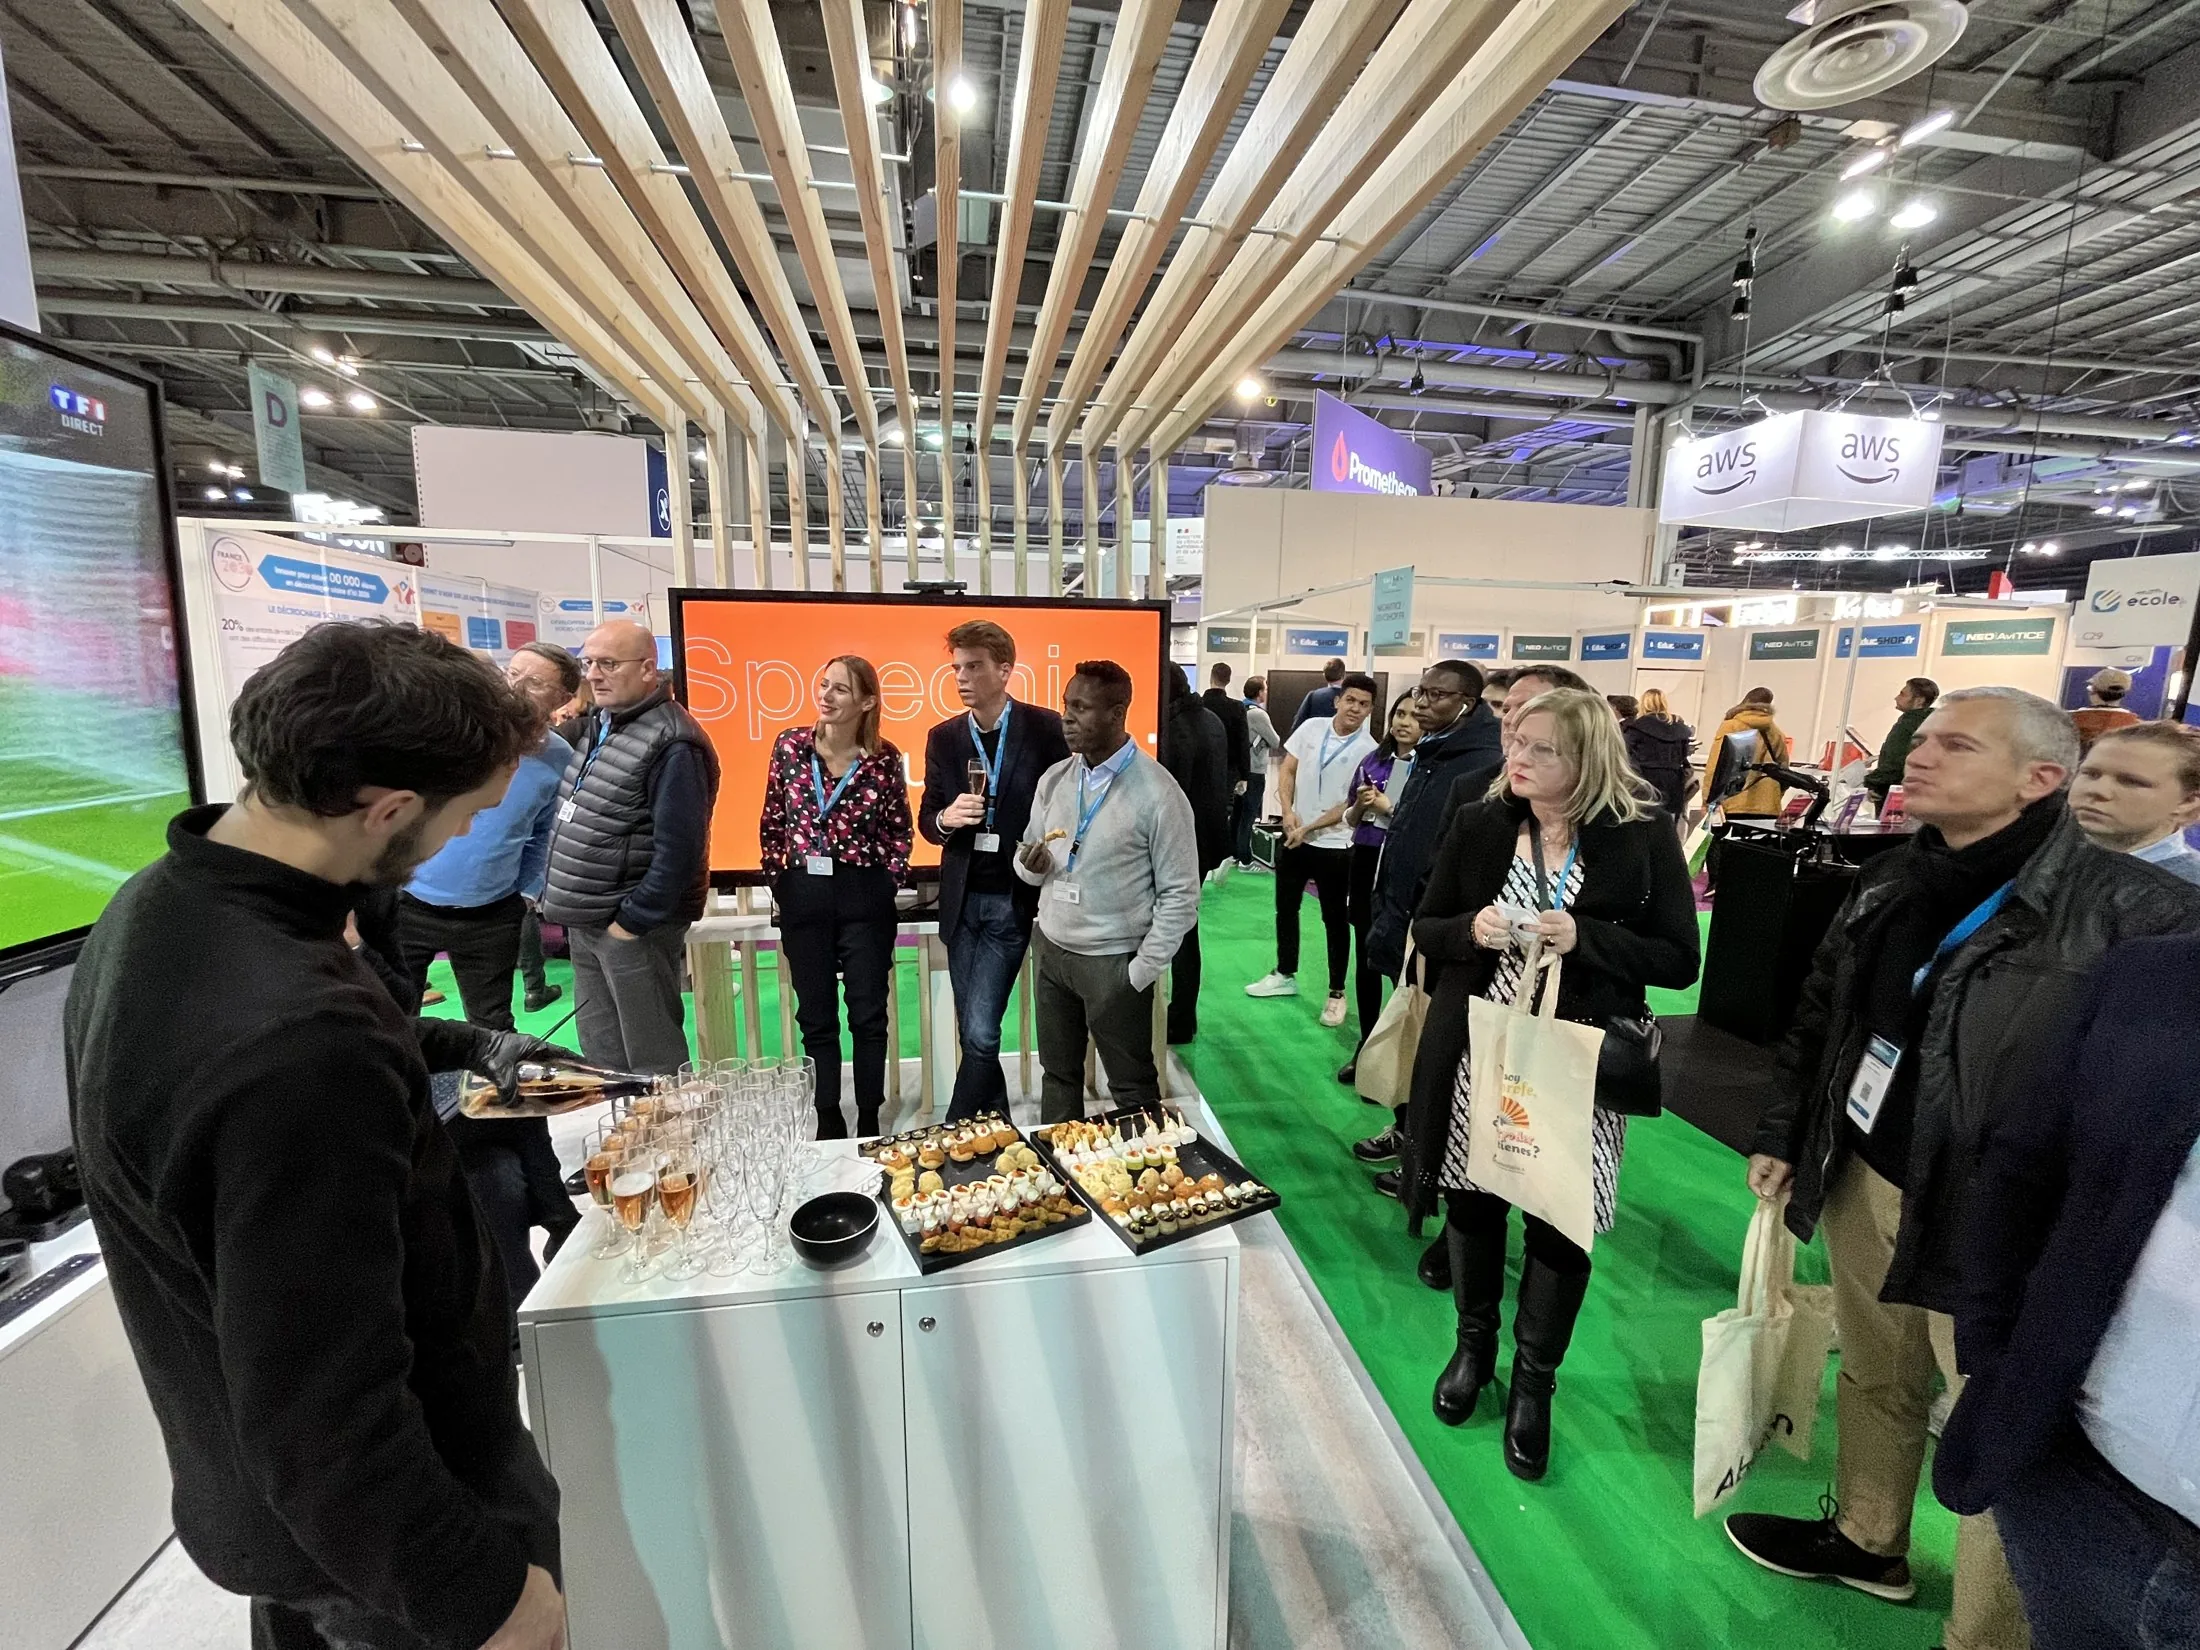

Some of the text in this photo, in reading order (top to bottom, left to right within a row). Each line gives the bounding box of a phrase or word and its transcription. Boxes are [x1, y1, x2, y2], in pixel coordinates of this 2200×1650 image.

[53, 387, 105, 422] TF1
[264, 391, 289, 429] D
[61, 413, 104, 437] DIRECT
[1696, 441, 1757, 479] aws
[1841, 432, 1901, 463] aws
[1349, 451, 1418, 497] Promethean
[217, 550, 244, 563] FRANCE
[2126, 591, 2181, 607] ecole
[221, 618, 244, 633] 20%
[1859, 636, 1916, 646] ducSHOP.fr
